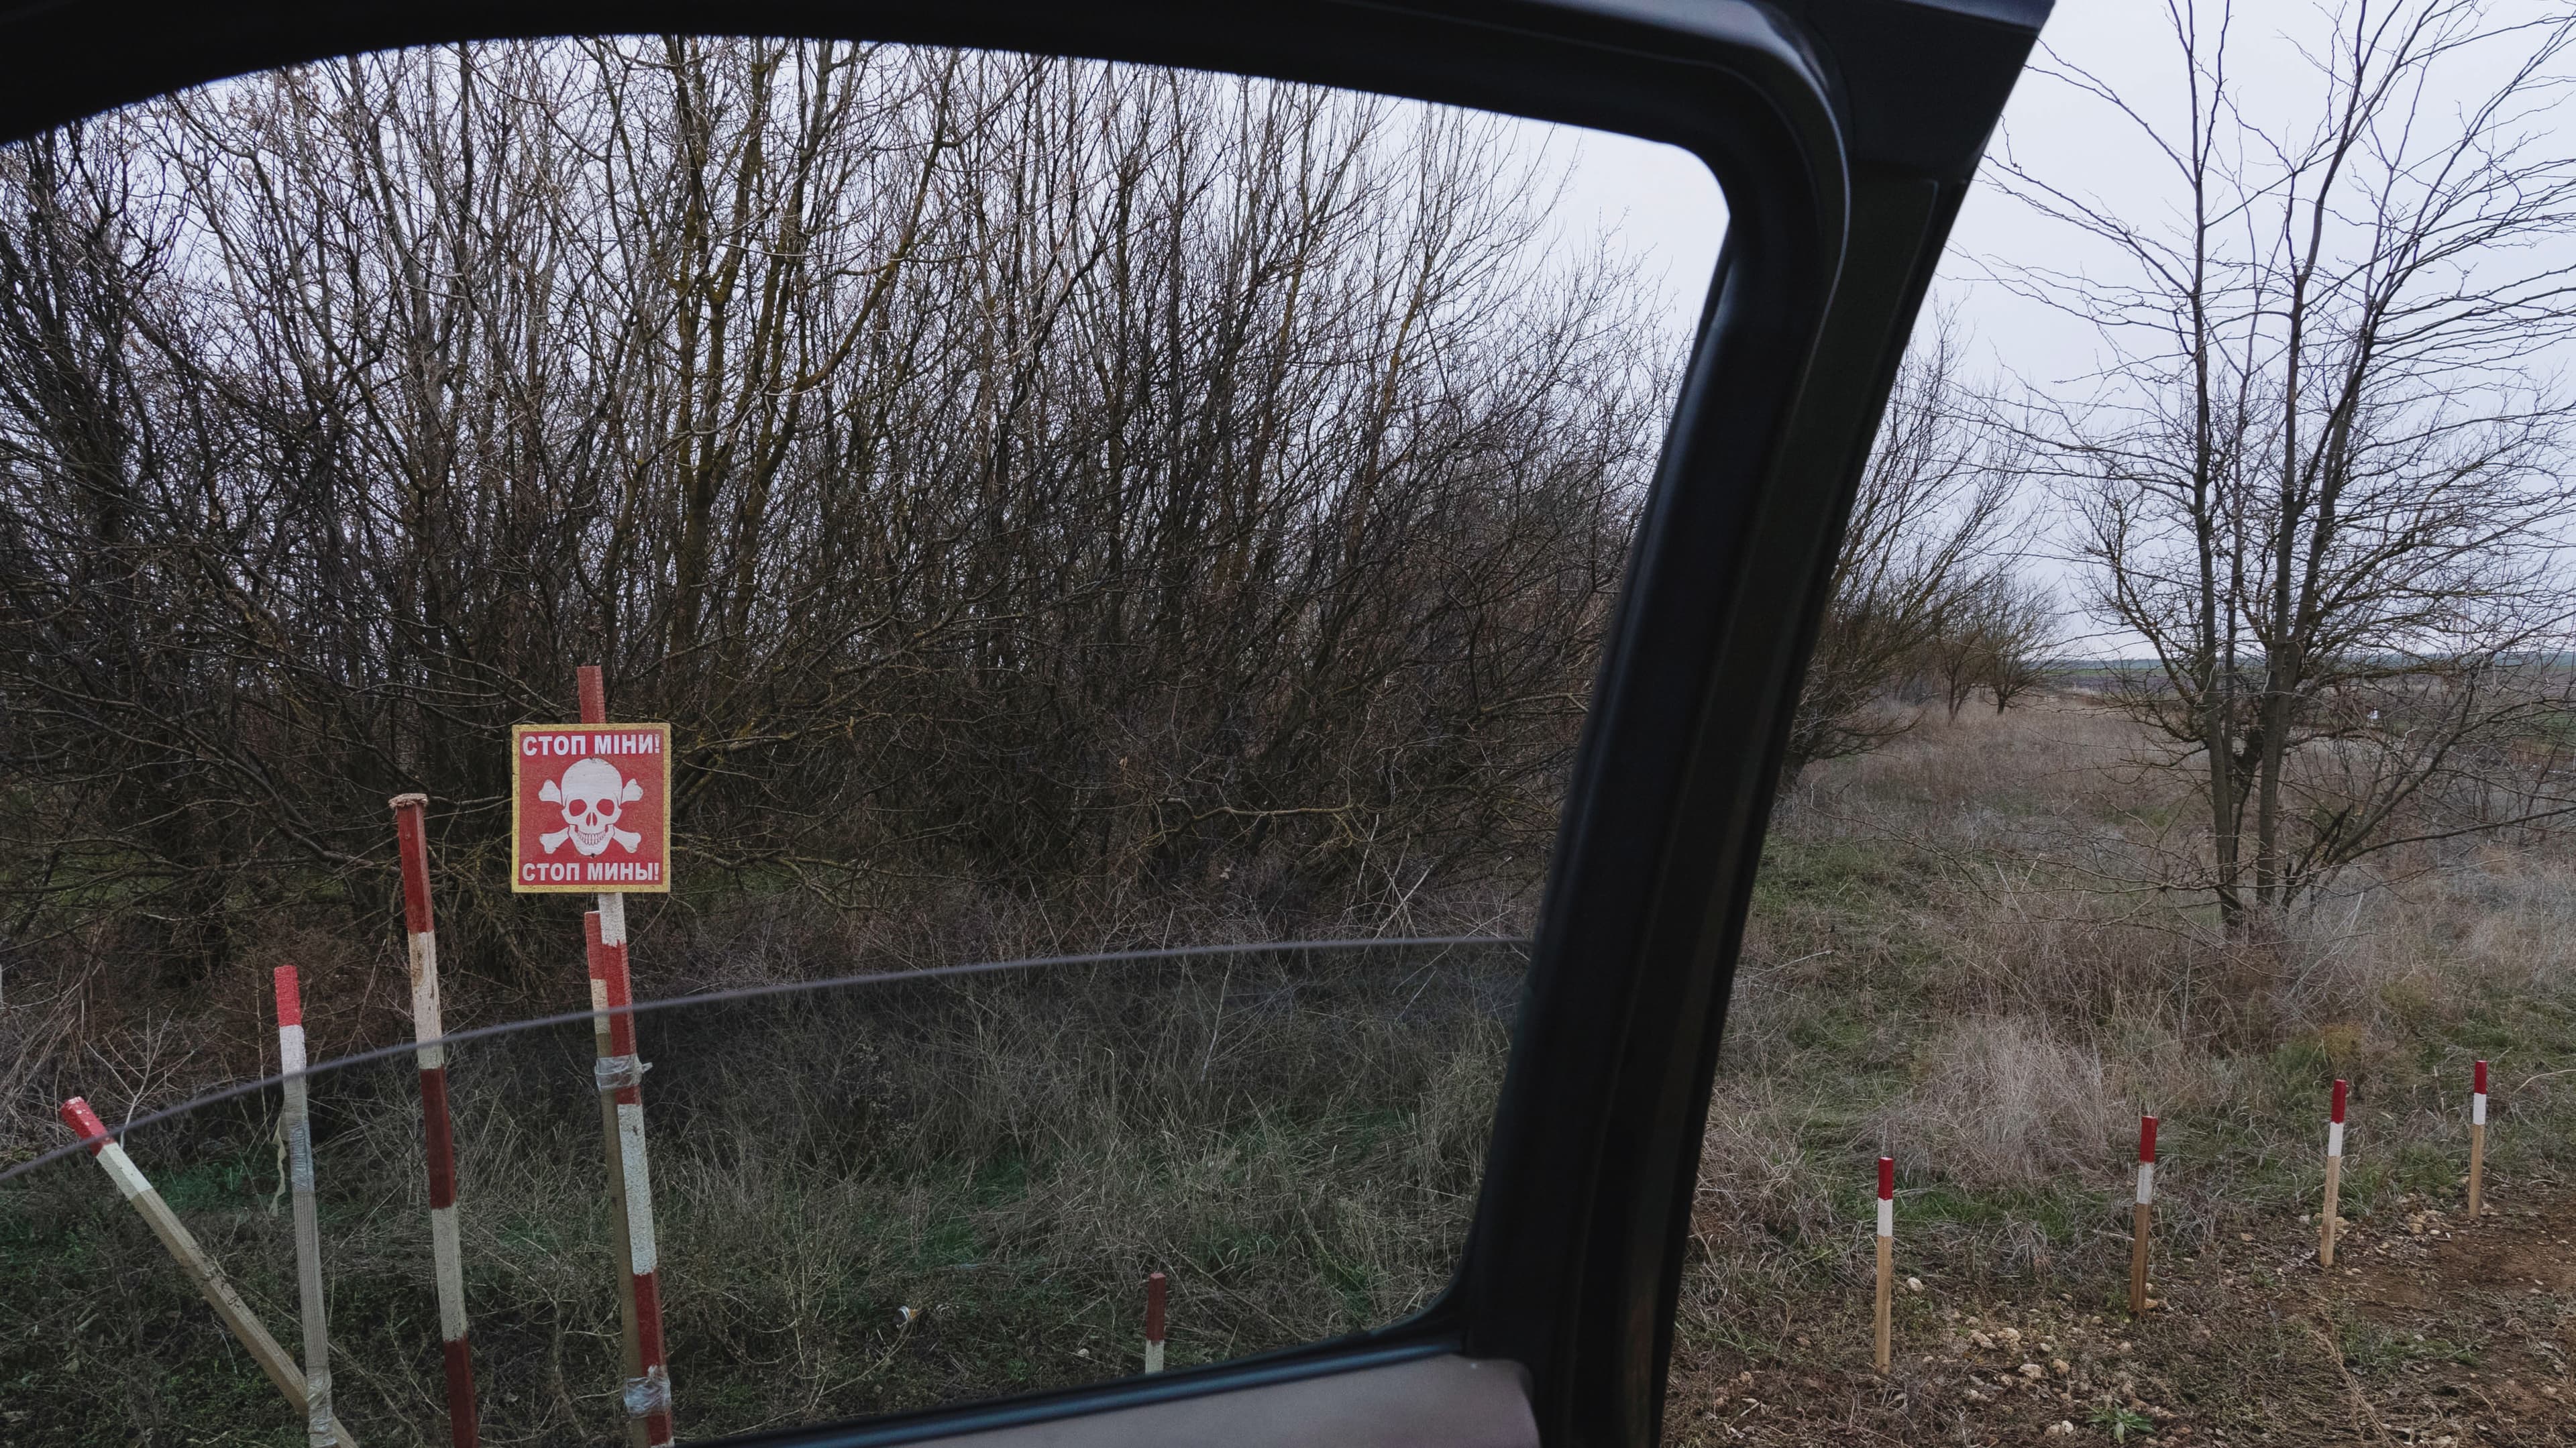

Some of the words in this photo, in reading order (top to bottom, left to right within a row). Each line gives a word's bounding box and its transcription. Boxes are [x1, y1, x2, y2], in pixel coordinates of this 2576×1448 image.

[523, 735, 586, 756] СТОП
[594, 734, 660, 755] МІНИ!
[522, 862, 580, 881] СТОП
[587, 862, 659, 881] МИНЫ!
